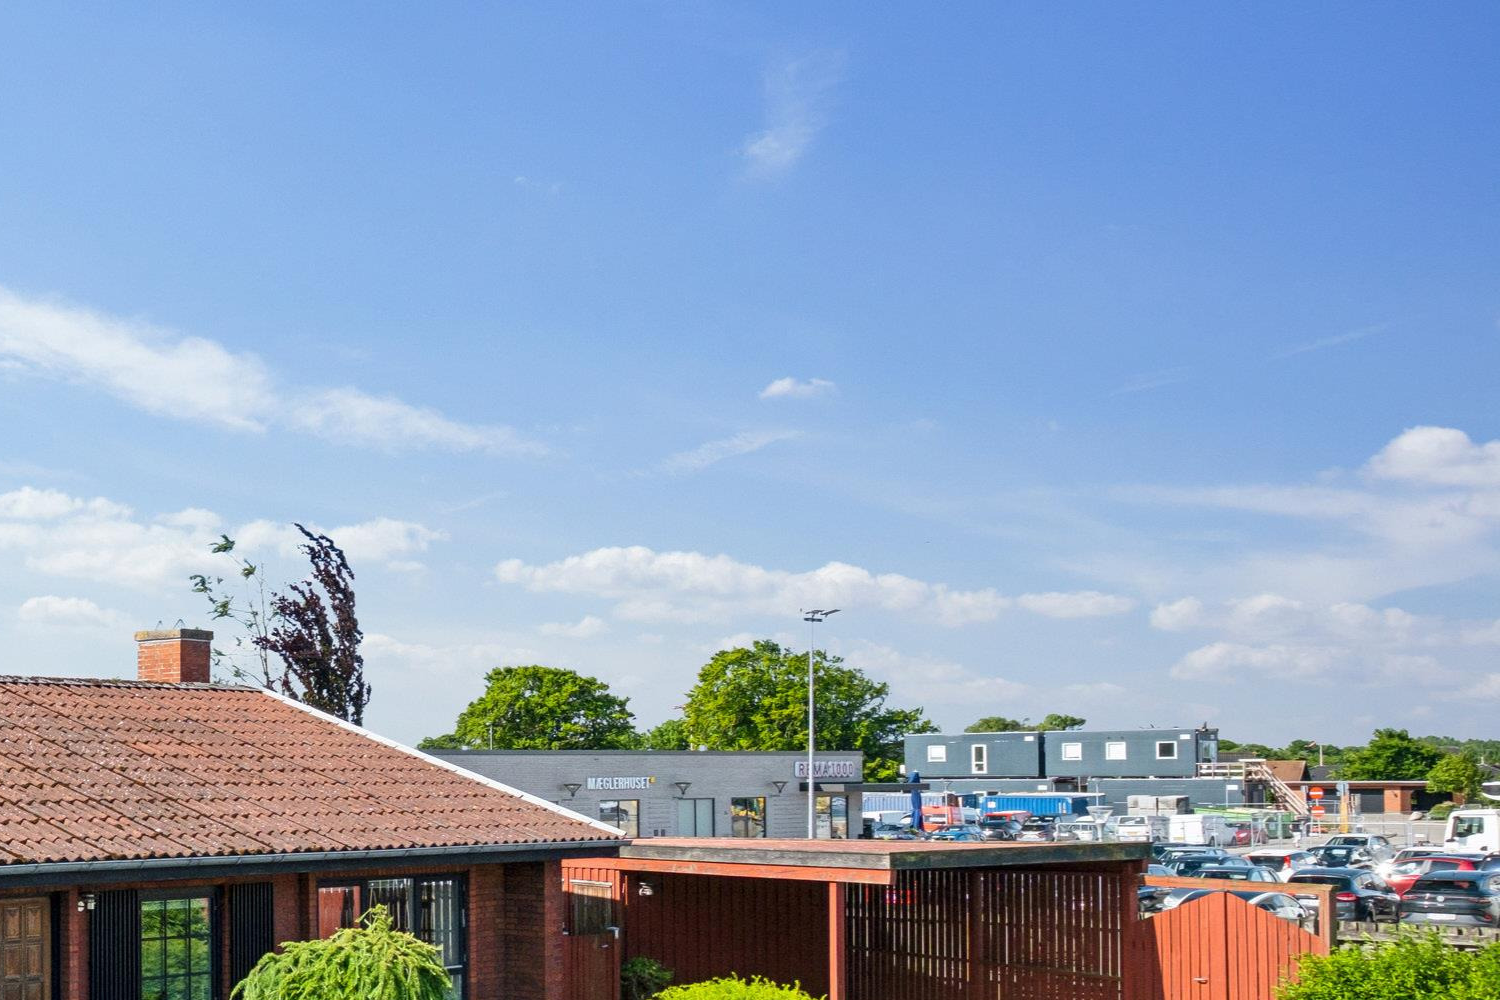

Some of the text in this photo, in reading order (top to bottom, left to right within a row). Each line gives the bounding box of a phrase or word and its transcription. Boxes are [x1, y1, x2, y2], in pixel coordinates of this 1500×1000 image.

[798, 762, 854, 776] REMA 1000
[587, 776, 650, 790] MÆGLERHUSET
